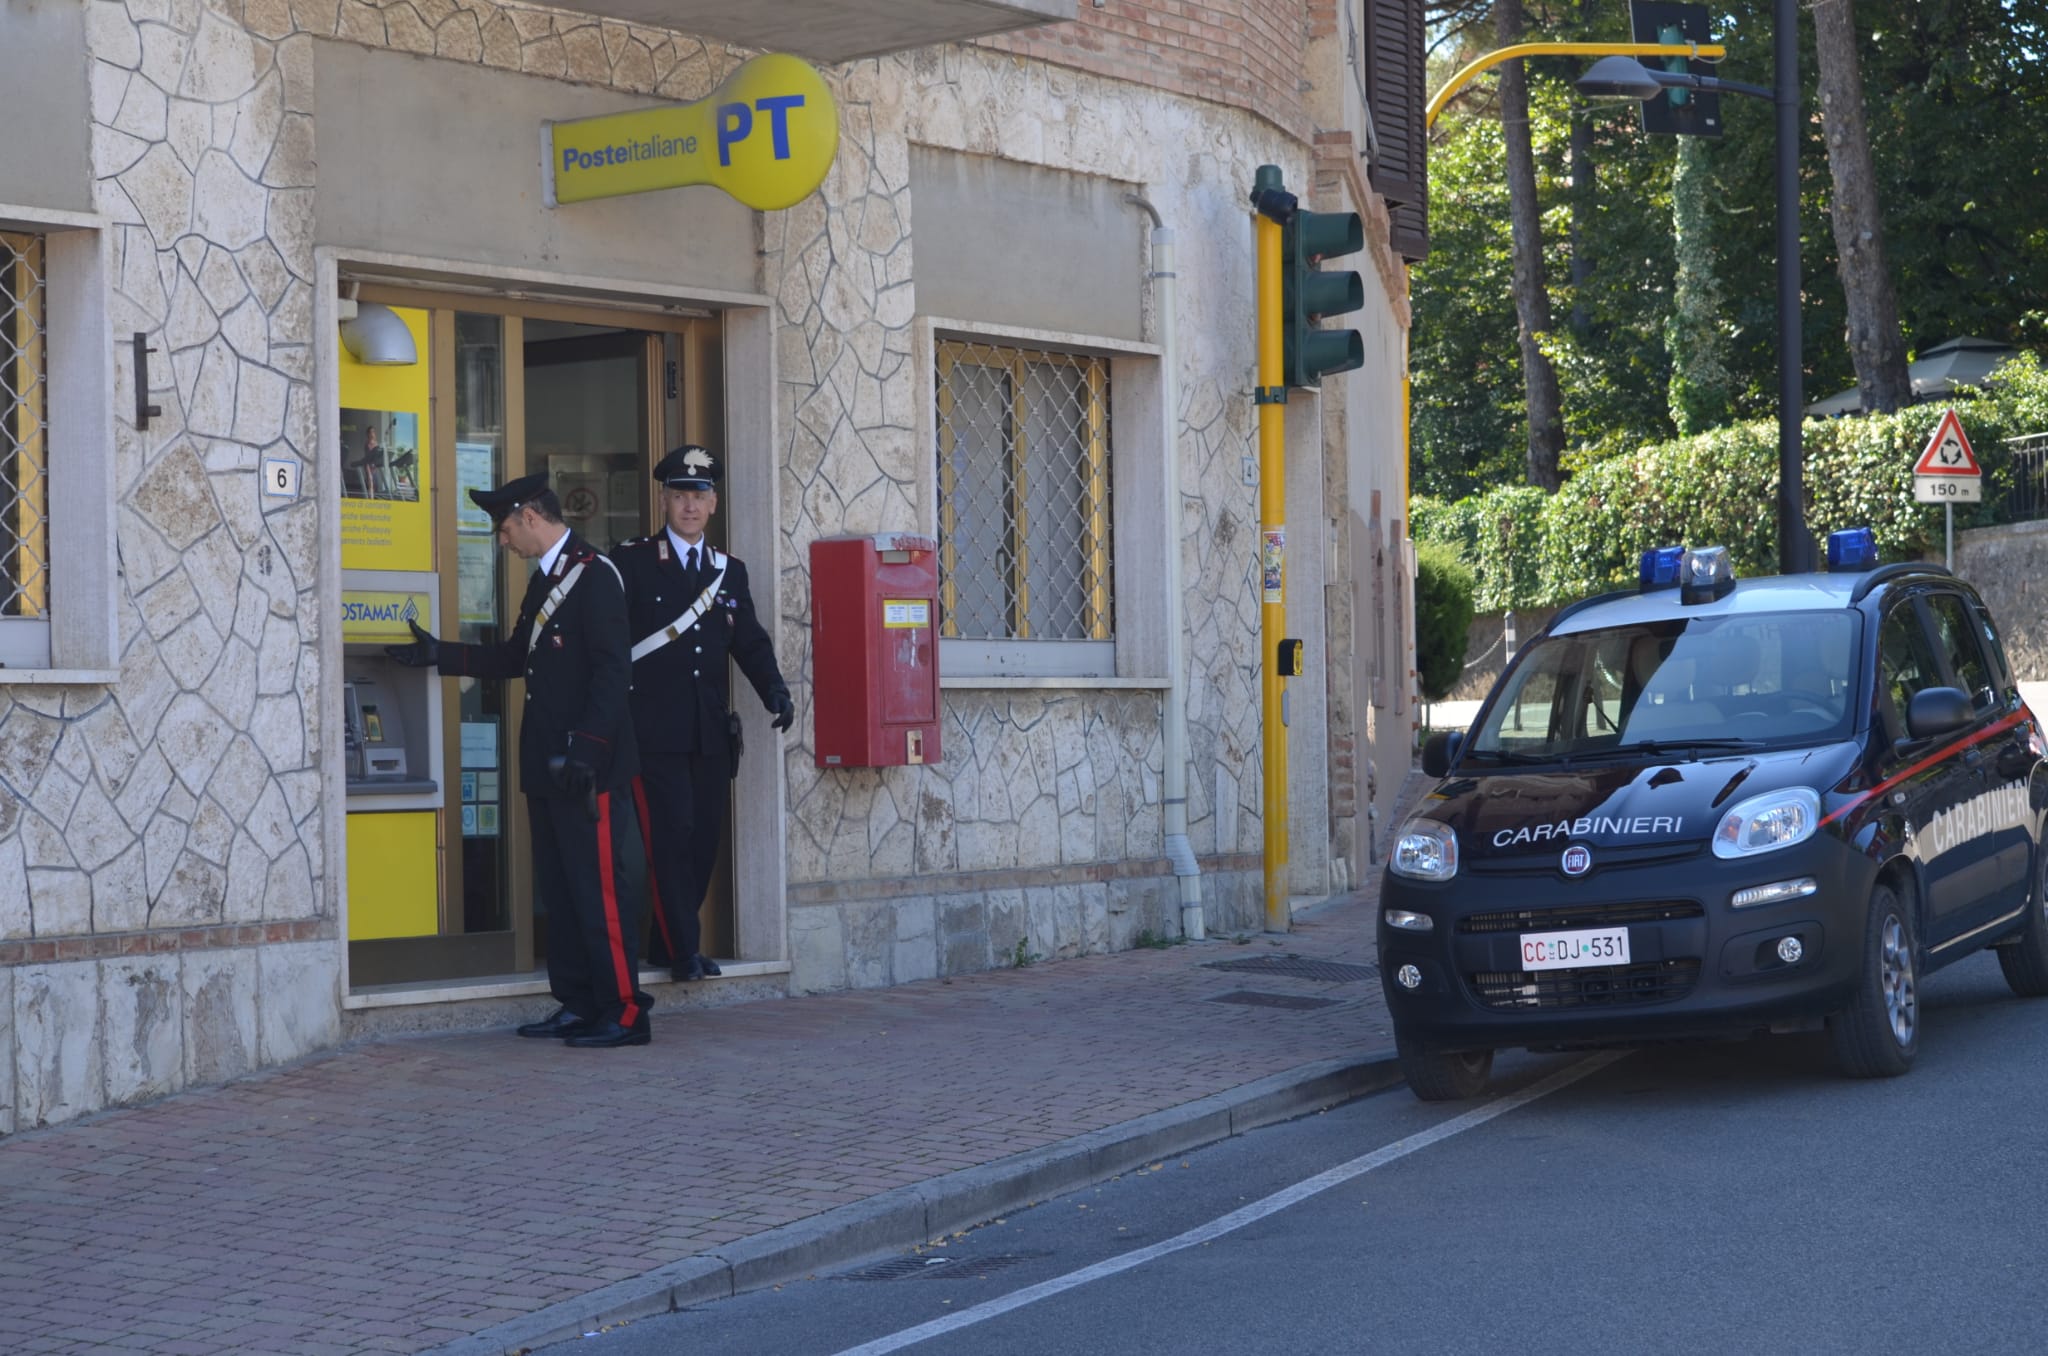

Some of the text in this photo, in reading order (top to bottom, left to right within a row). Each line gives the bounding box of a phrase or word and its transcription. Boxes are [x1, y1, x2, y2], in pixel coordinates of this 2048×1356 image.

[716, 94, 805, 168] PT
[277, 467, 288, 489] 6
[1930, 483, 1969, 496] 150 m
[1932, 775, 2031, 854] CARABINIERI
[1492, 816, 1682, 847] CARABINIERI
[1568, 853, 1584, 868] FIAT
[1523, 935, 1623, 962] CC DJ 531
